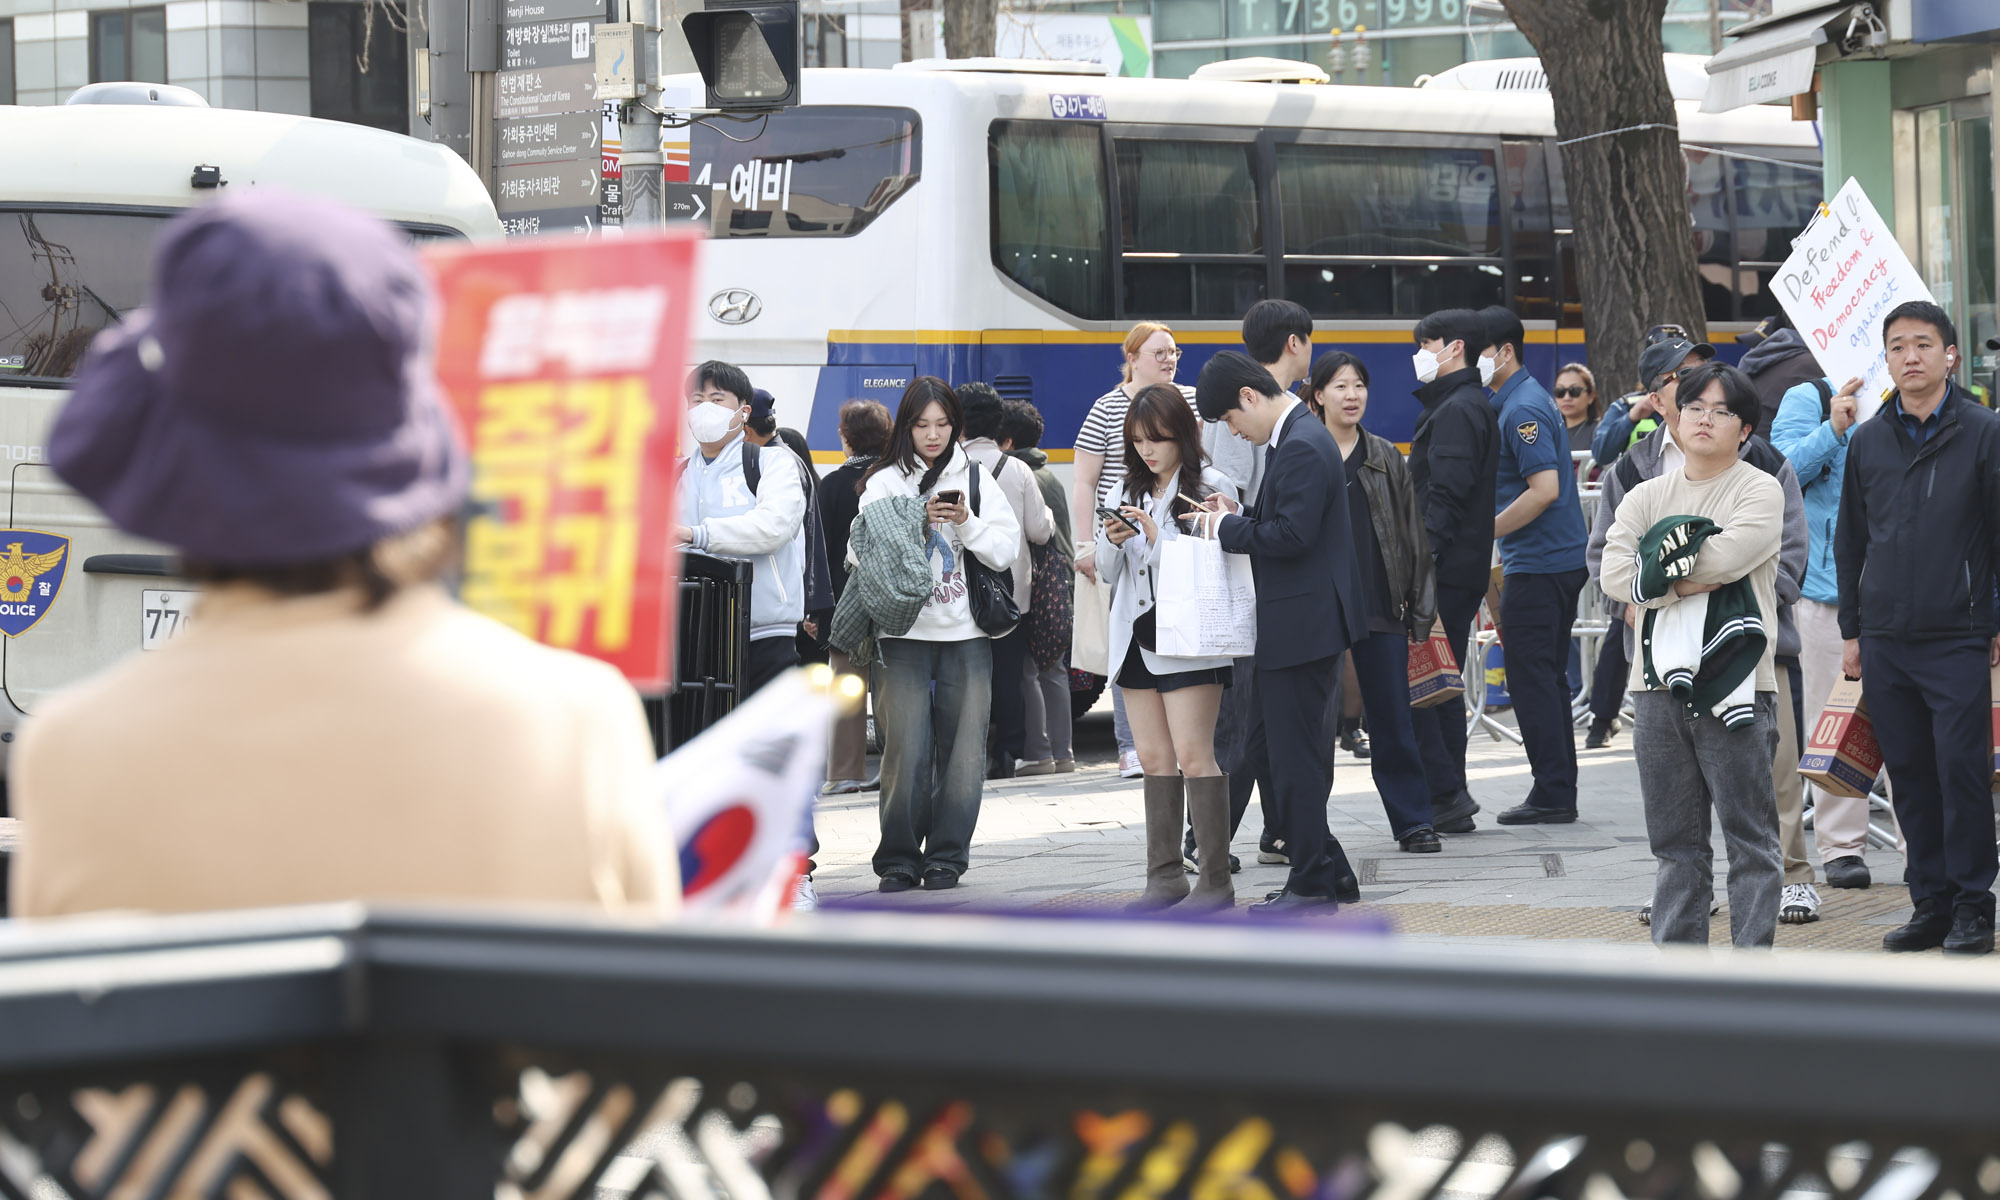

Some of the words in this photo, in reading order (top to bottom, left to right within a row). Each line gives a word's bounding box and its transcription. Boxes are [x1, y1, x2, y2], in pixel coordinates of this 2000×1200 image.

[507, 6, 524, 18] Hanji
[524, 5, 545, 15] House
[506, 25, 547, 46] 개방화장실
[507, 48, 521, 58] Toilet
[500, 72, 542, 94] 헌법재판소
[501, 96, 509, 106] The
[509, 93, 539, 106] Constitutional
[539, 92, 551, 103] Court
[552, 91, 557, 101] of
[557, 90, 571, 101] Korea
[502, 122, 557, 144] 가회동주민센터
[502, 149, 516, 159] Gahoe
[516, 148, 527, 159] dong
[547, 145, 562, 155] Service
[562, 144, 577, 154] Center
[501, 175, 560, 199] 가회동자치회관
[673, 202, 690, 211] 270m
[1783, 210, 1852, 303] Defend
[1812, 257, 1888, 351] Democracy
[864, 379, 906, 388] ELEGANCE
[721, 477, 749, 508] K
[39, 582, 51, 597] 찰
